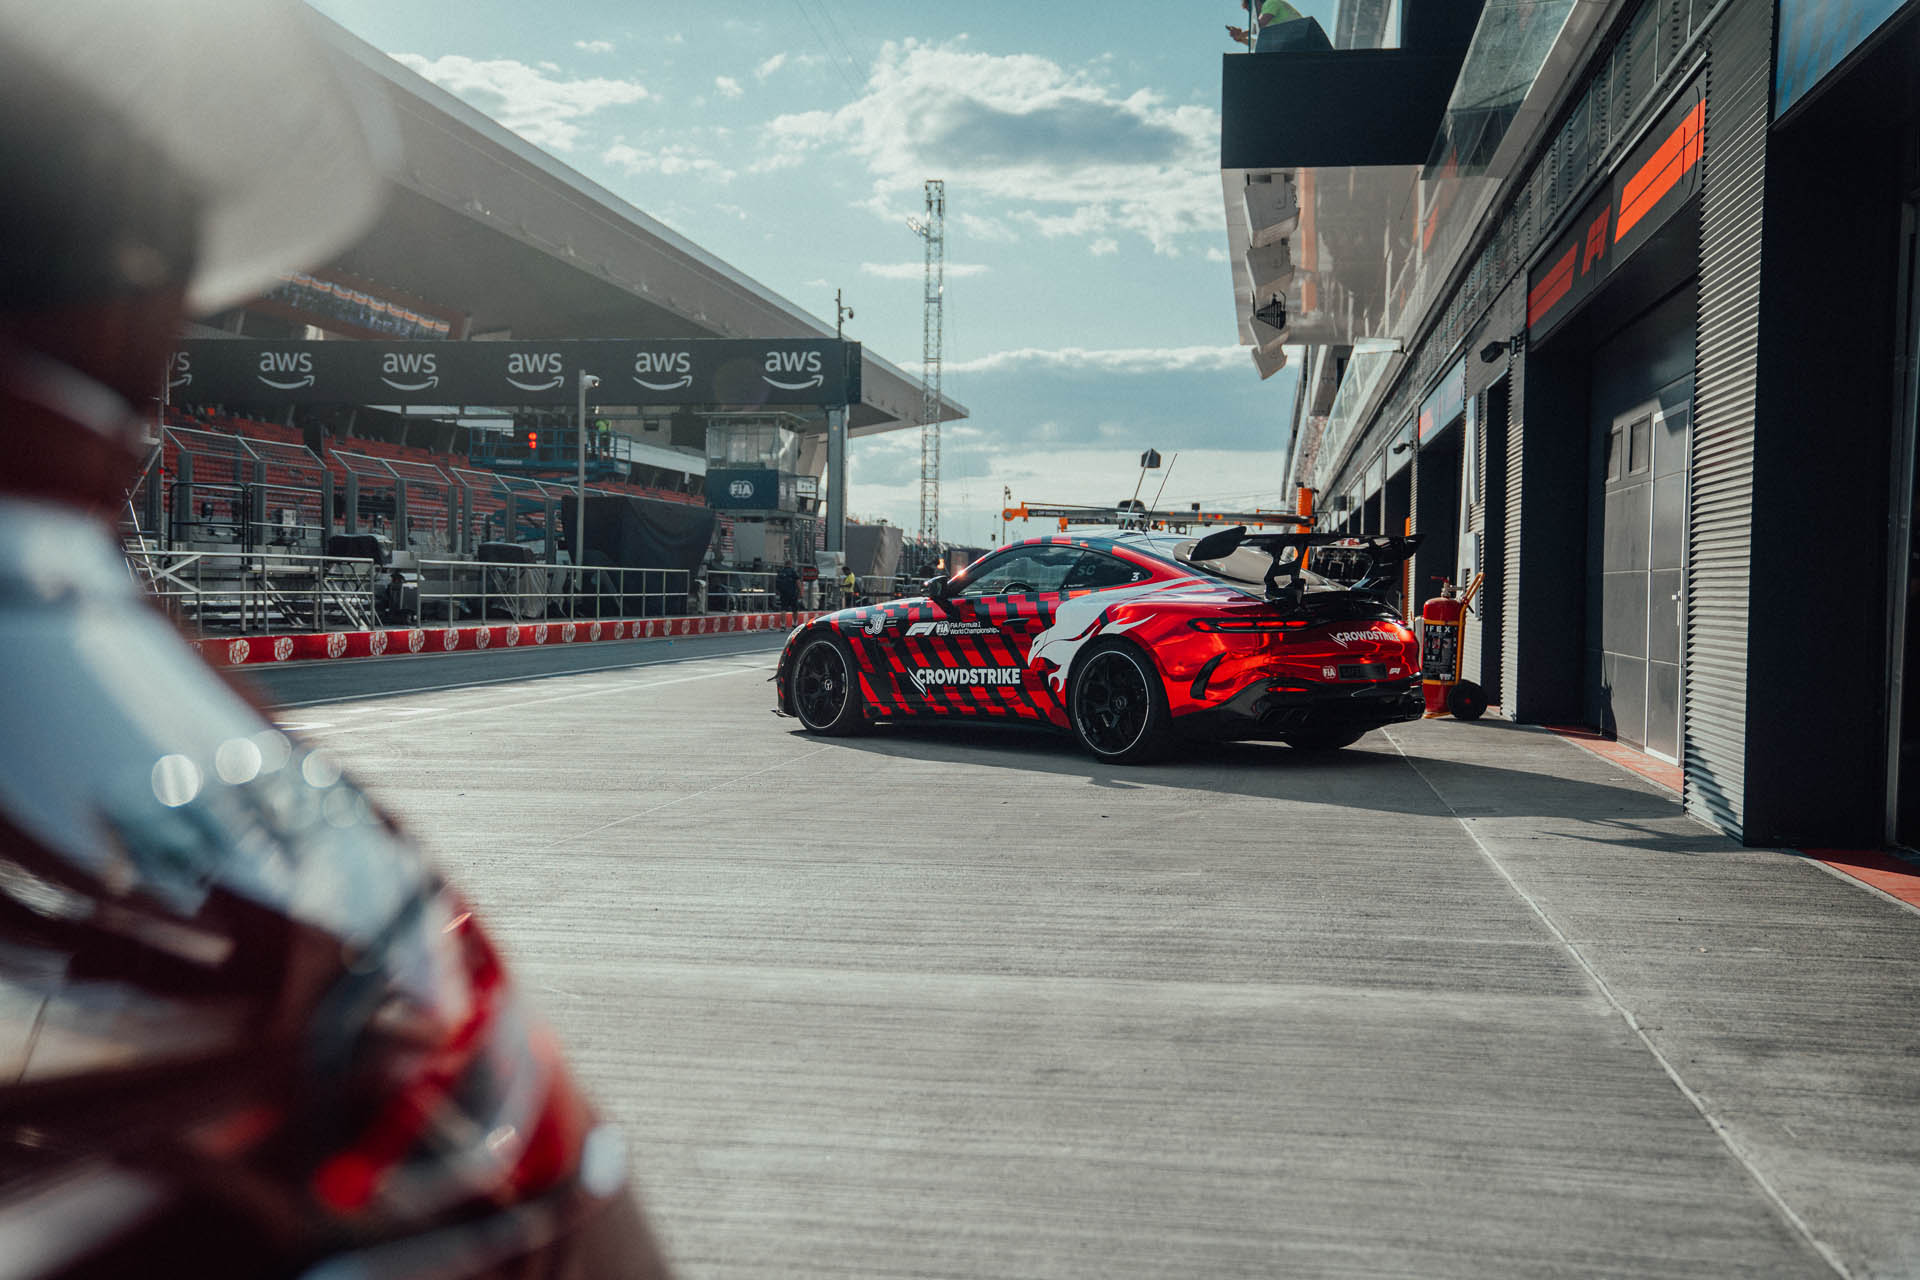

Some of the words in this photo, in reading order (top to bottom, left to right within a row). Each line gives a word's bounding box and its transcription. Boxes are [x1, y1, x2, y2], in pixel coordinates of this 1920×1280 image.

[259, 352, 313, 372] aws
[383, 353, 436, 373] aws
[508, 352, 562, 373] aws
[635, 351, 690, 372] aws
[765, 350, 821, 372] aws
[730, 482, 753, 496] FIA
[936, 622, 949, 634] FIA
[1336, 630, 1400, 642] CROWDSTRIKE
[916, 668, 1021, 684] CROWDSTRIKE
[1322, 666, 1337, 679] FIA
